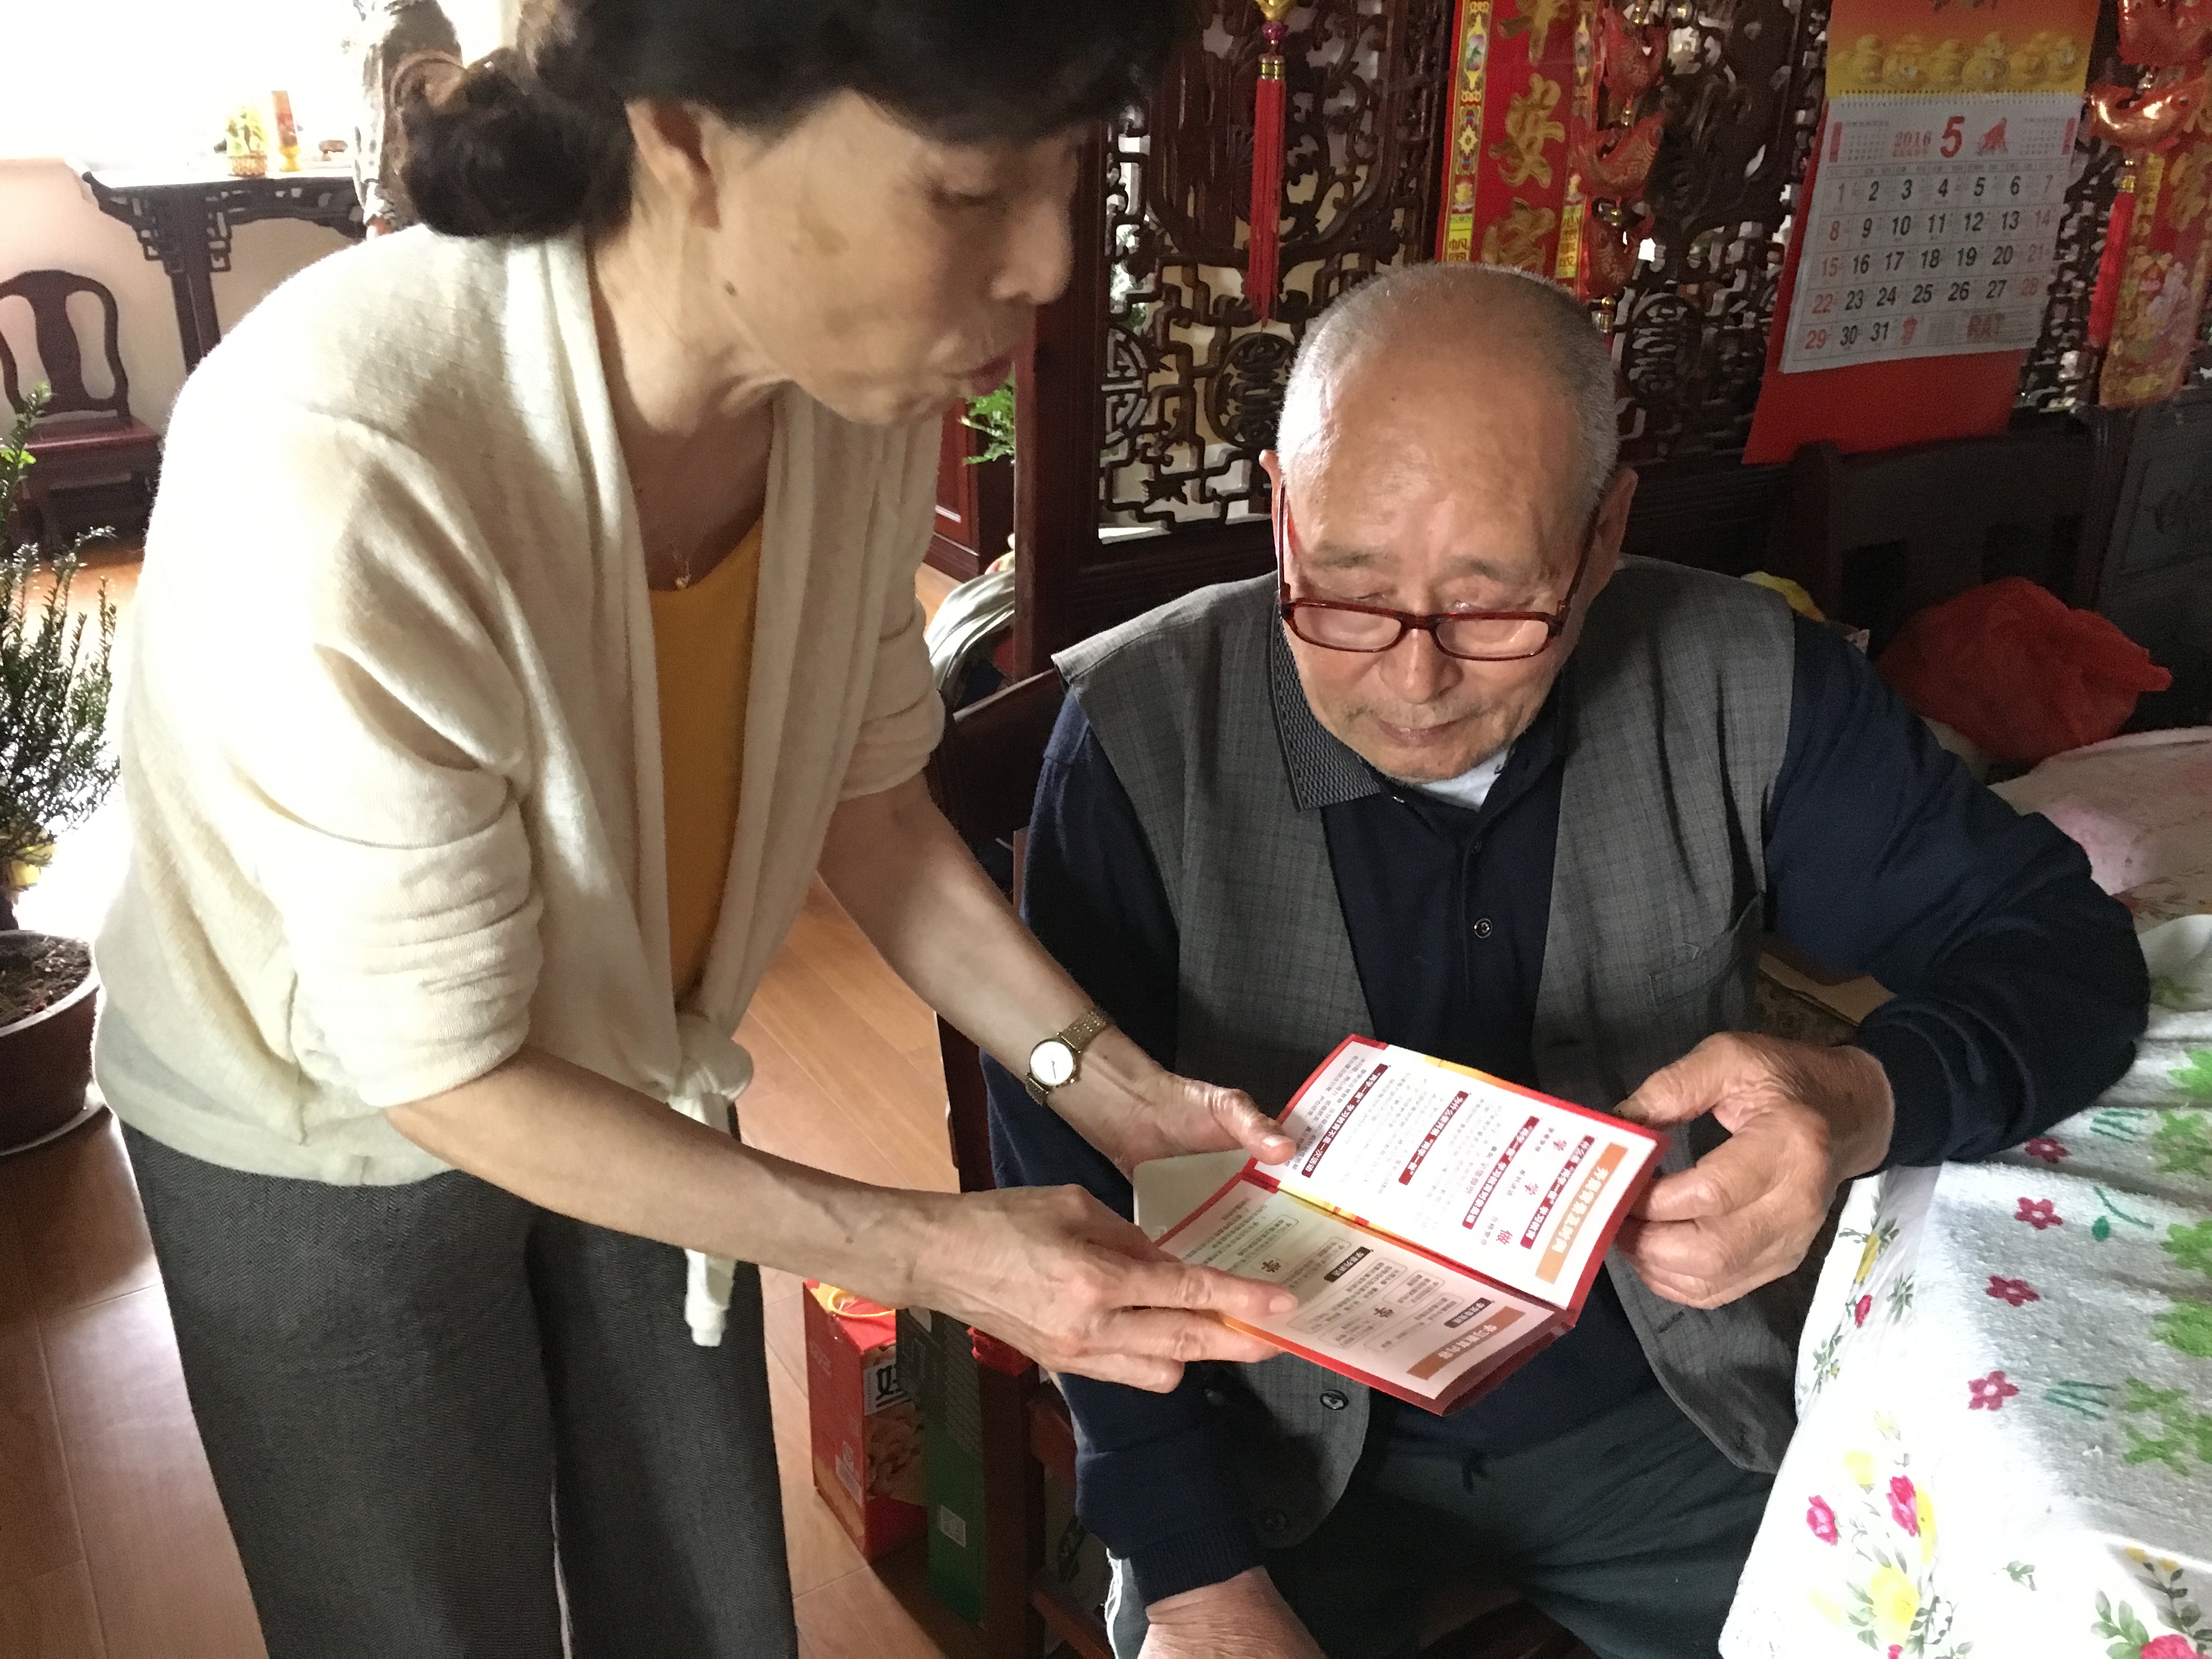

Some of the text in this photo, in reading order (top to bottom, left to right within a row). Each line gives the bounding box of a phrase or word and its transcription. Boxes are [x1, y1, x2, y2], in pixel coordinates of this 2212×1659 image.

[1940, 116, 1965, 158] 5
[1838, 174, 2053, 204] 1 2 3 4 5 6 7
[1829, 209, 2051, 241] 8 9 10 11 12 13 14
[1822, 244, 2044, 276] 15 16 17 18 19 20 21
[1812, 277, 2039, 314] 22 23 24 25 26 27 28
[1804, 329, 1827, 349] 29
[1840, 325, 1858, 346] 30
[1870, 321, 1889, 342] 31
[1303, 1070, 1381, 1172] “两学一做”学习教育不是一次活动
[1493, 1228, 1515, 1246] 做
[1257, 1258, 1284, 1274] 学
[1370, 1305, 1396, 1320] 学
[1436, 1323, 1499, 1360] 学习教育内容
